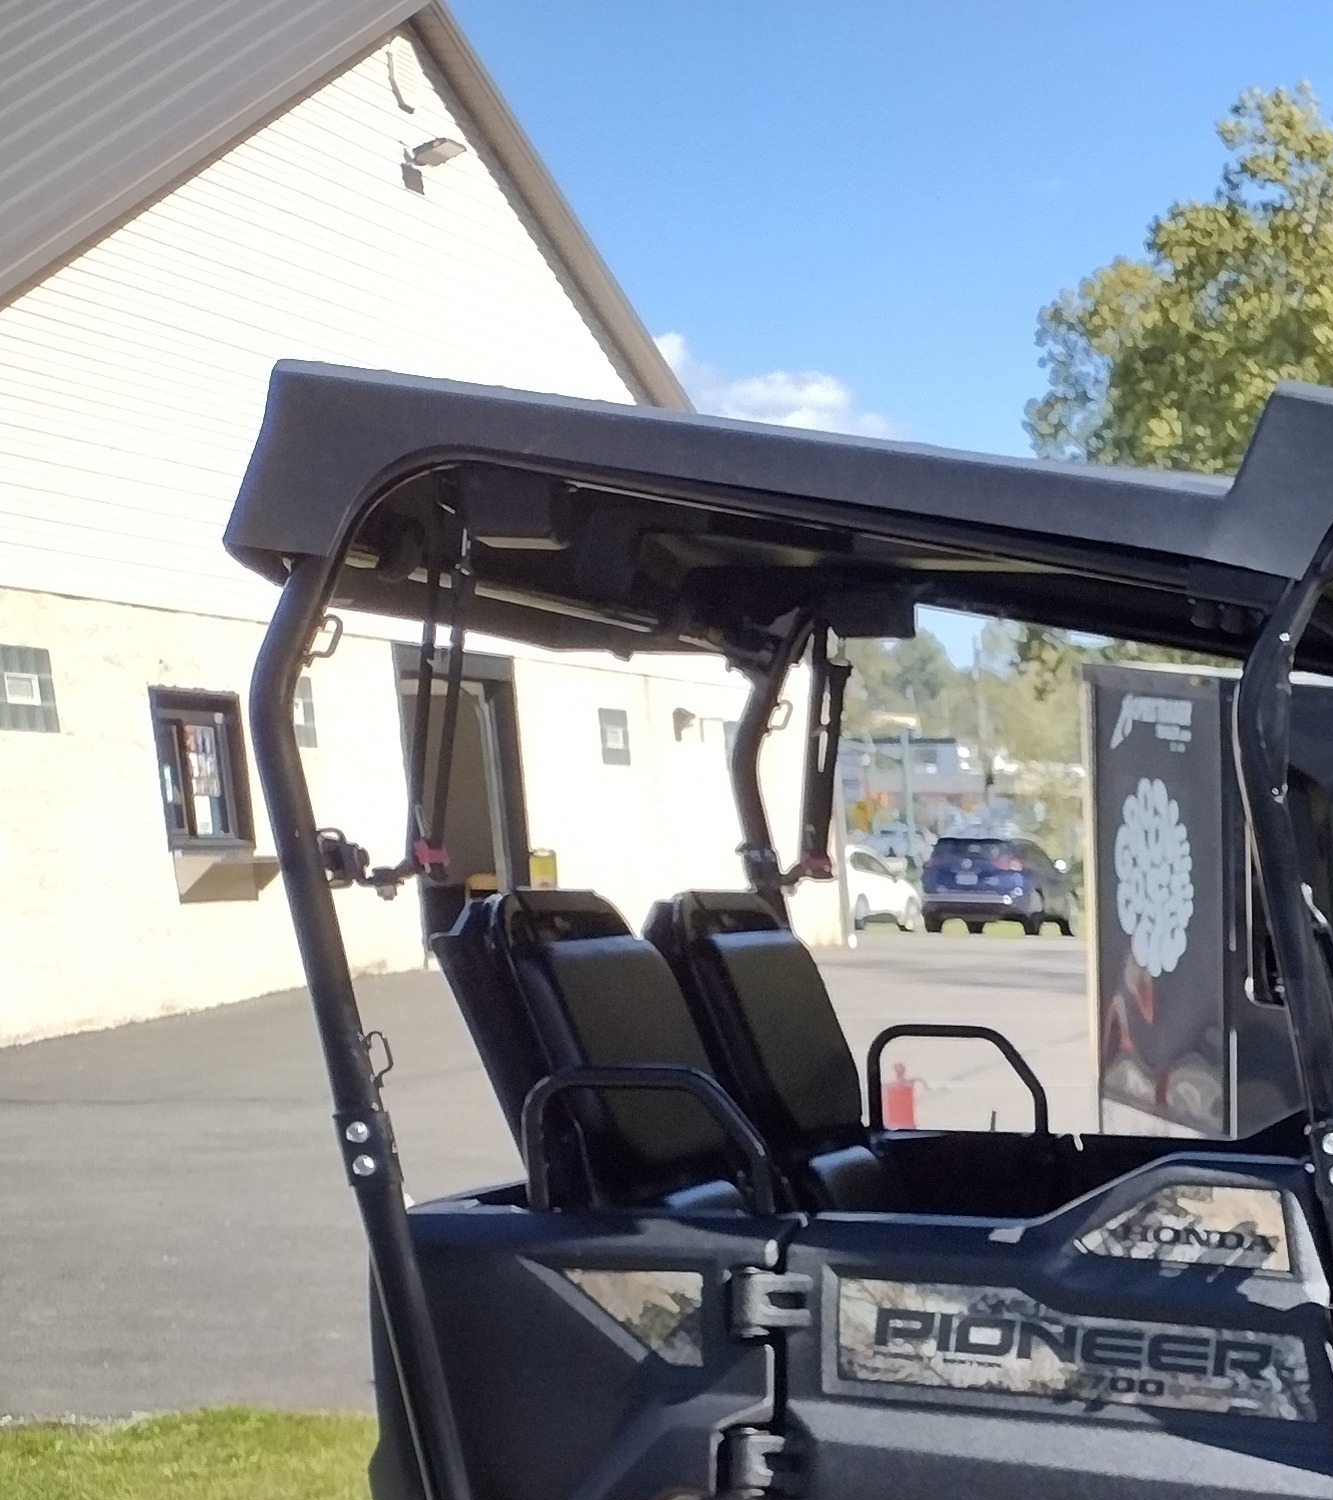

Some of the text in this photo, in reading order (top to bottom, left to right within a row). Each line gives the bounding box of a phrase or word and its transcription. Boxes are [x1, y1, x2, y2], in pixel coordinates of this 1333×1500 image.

[1122, 1224, 1279, 1254] HONDA
[875, 1308, 1273, 1380] PIONEER
[1091, 1375, 1165, 1397] 700
